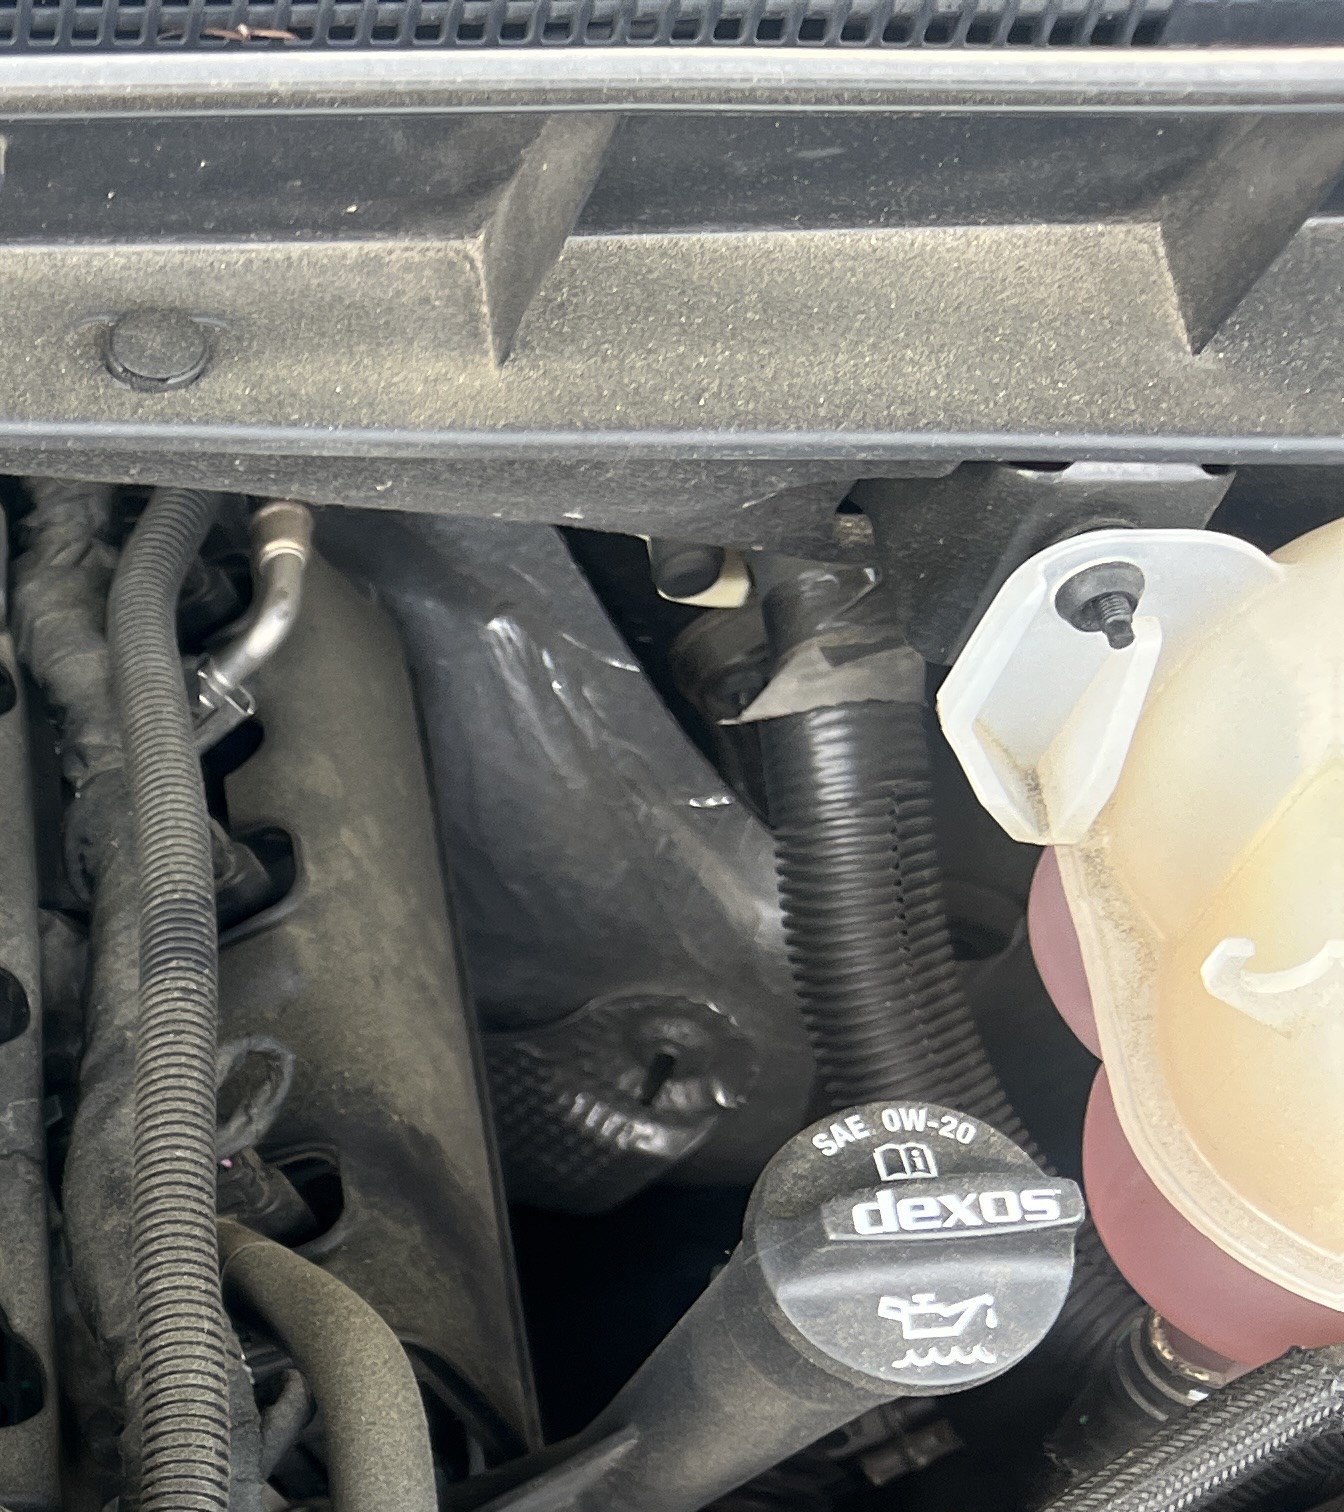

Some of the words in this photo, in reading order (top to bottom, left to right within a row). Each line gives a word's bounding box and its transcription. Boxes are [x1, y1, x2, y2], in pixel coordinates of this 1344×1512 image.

[812, 1115, 869, 1156] SAE
[881, 1108, 976, 1144] 0W-20
[852, 1189, 1061, 1234] dexos
